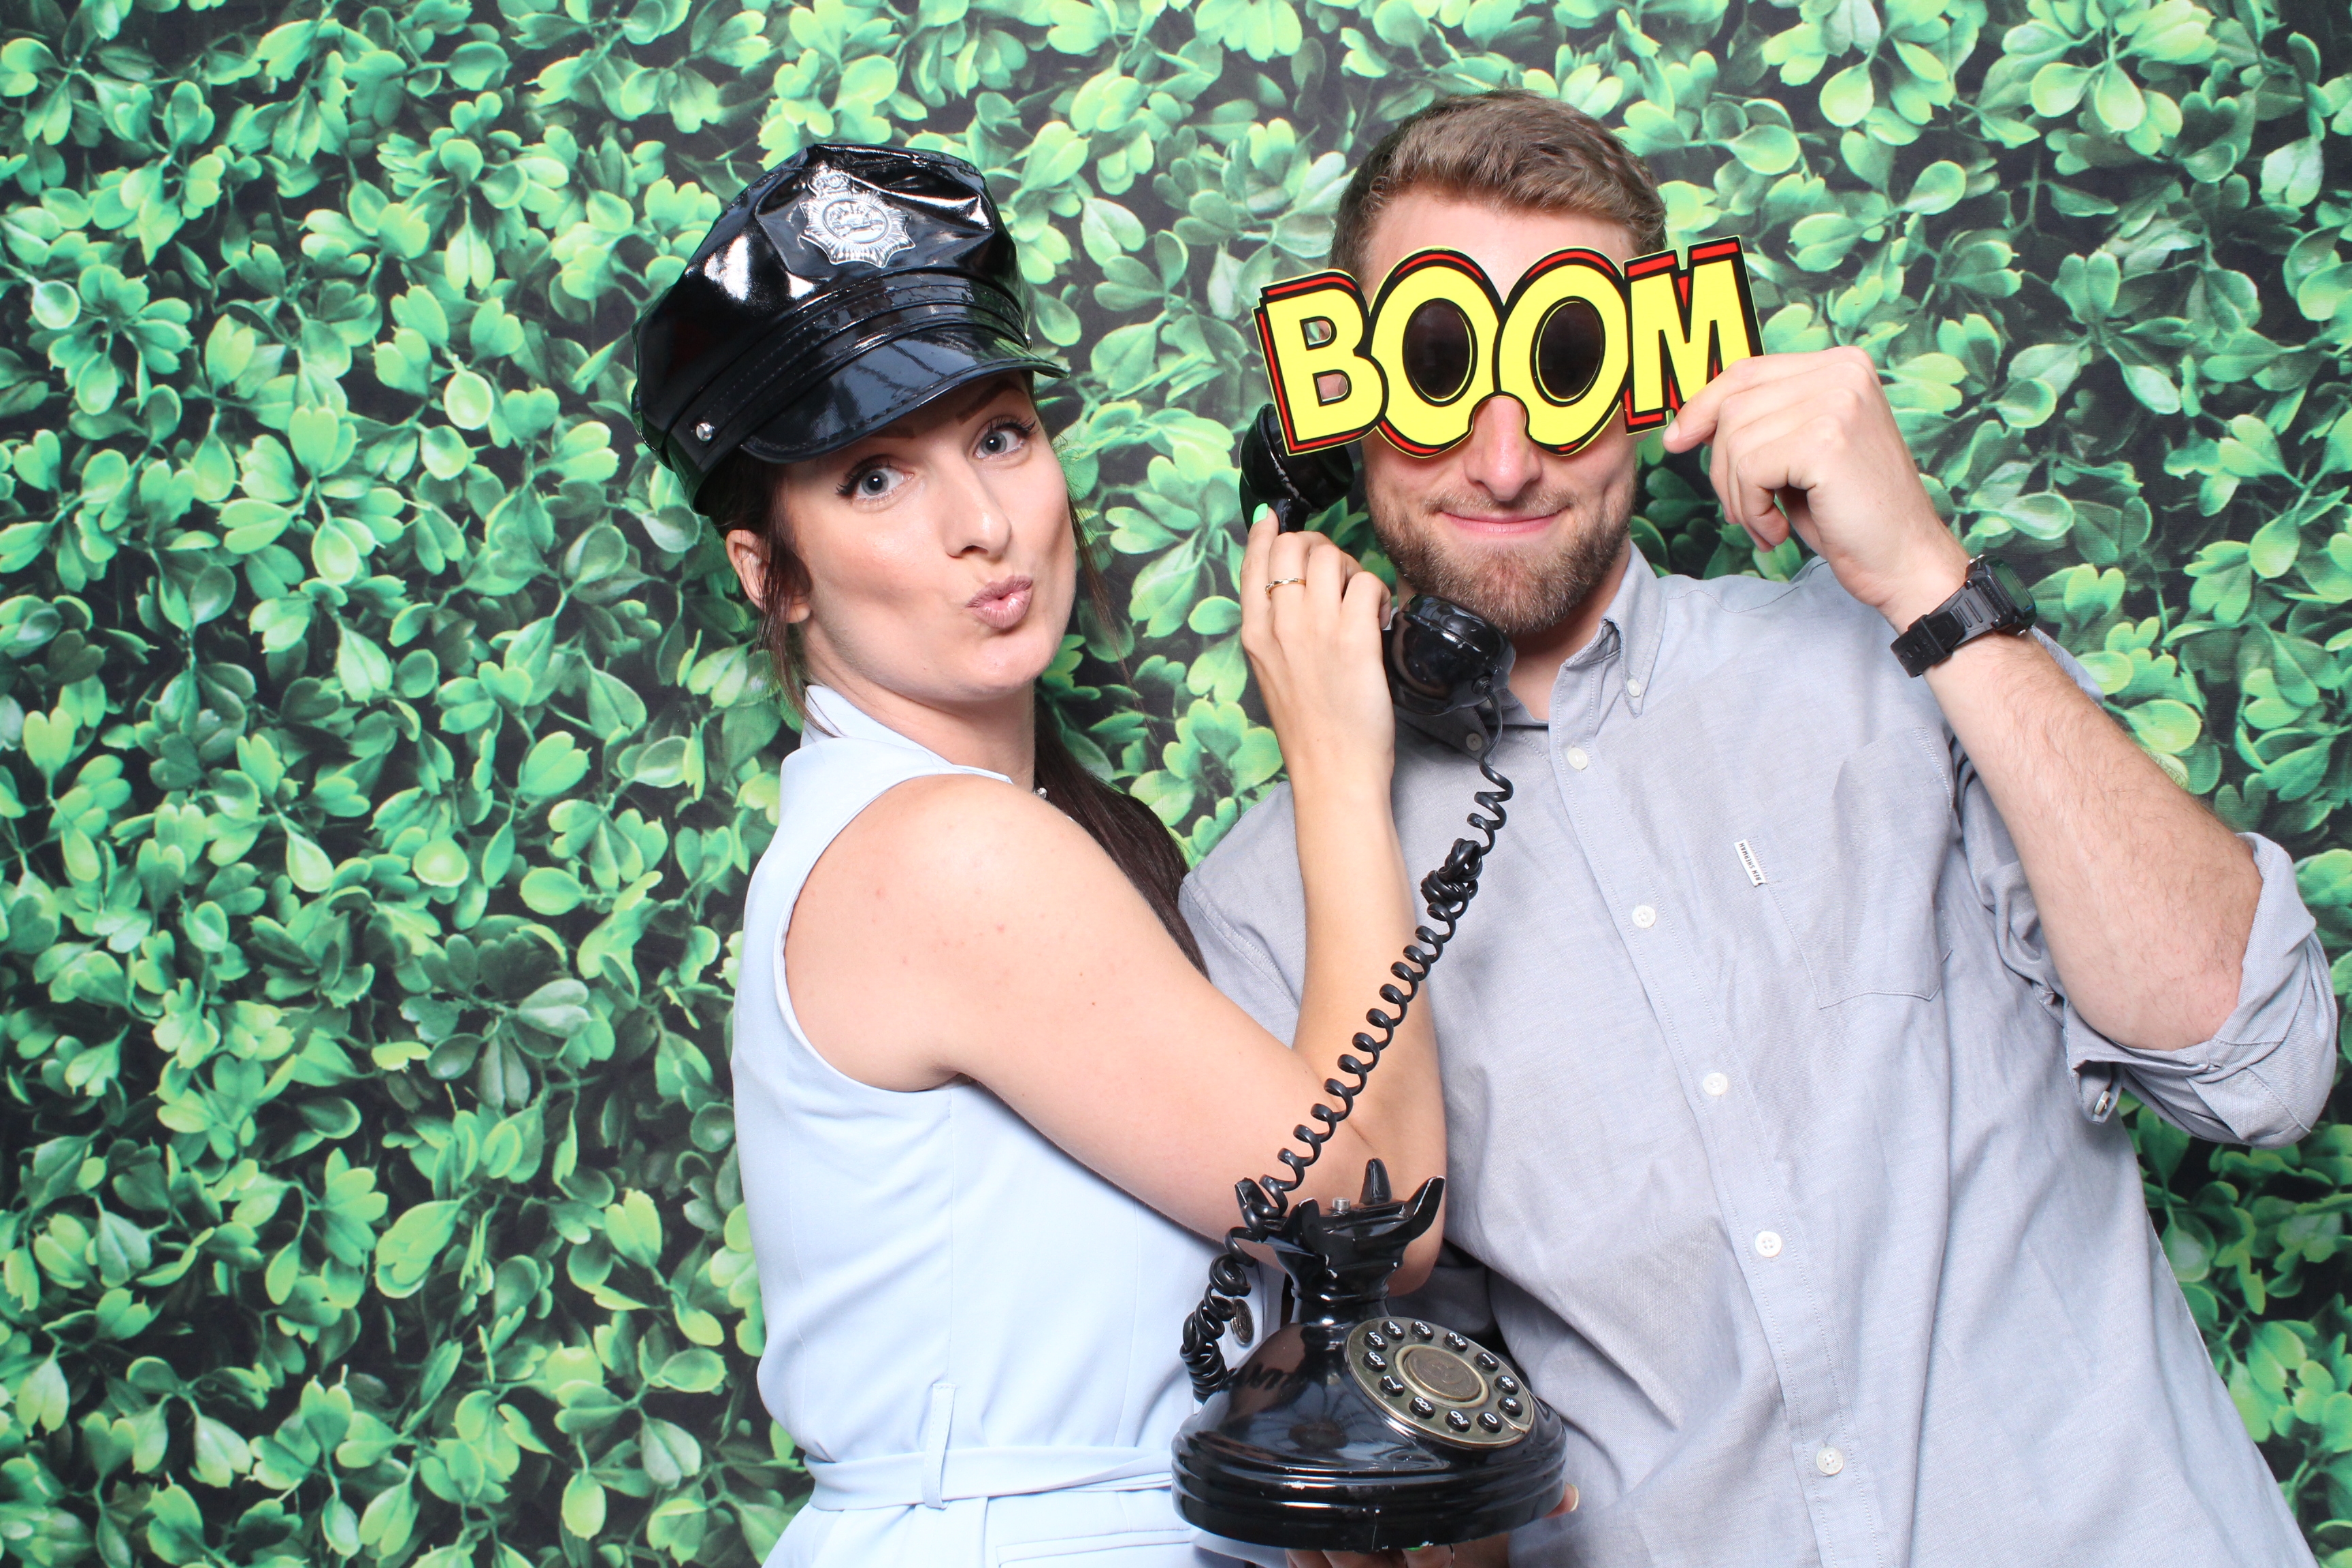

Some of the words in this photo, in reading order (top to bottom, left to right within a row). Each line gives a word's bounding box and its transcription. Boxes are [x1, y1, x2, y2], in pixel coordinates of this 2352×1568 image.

[1254, 236, 1764, 456] BOOM
[1739, 843, 1755, 869] SHERMAN
[1752, 870, 1761, 881] BEN
[1388, 1321, 1399, 1330] 4
[1415, 1321, 1428, 1331] 3
[1369, 1332, 1382, 1342] 5
[1449, 1332, 1463, 1342] 2
[1369, 1352, 1382, 1362] 6
[1482, 1353, 1495, 1365] 1
[1383, 1375, 1396, 1387] 7
[1415, 1396, 1428, 1408] 8
[1450, 1410, 1464, 1422] 9
[1484, 1413, 1497, 1424] 0
